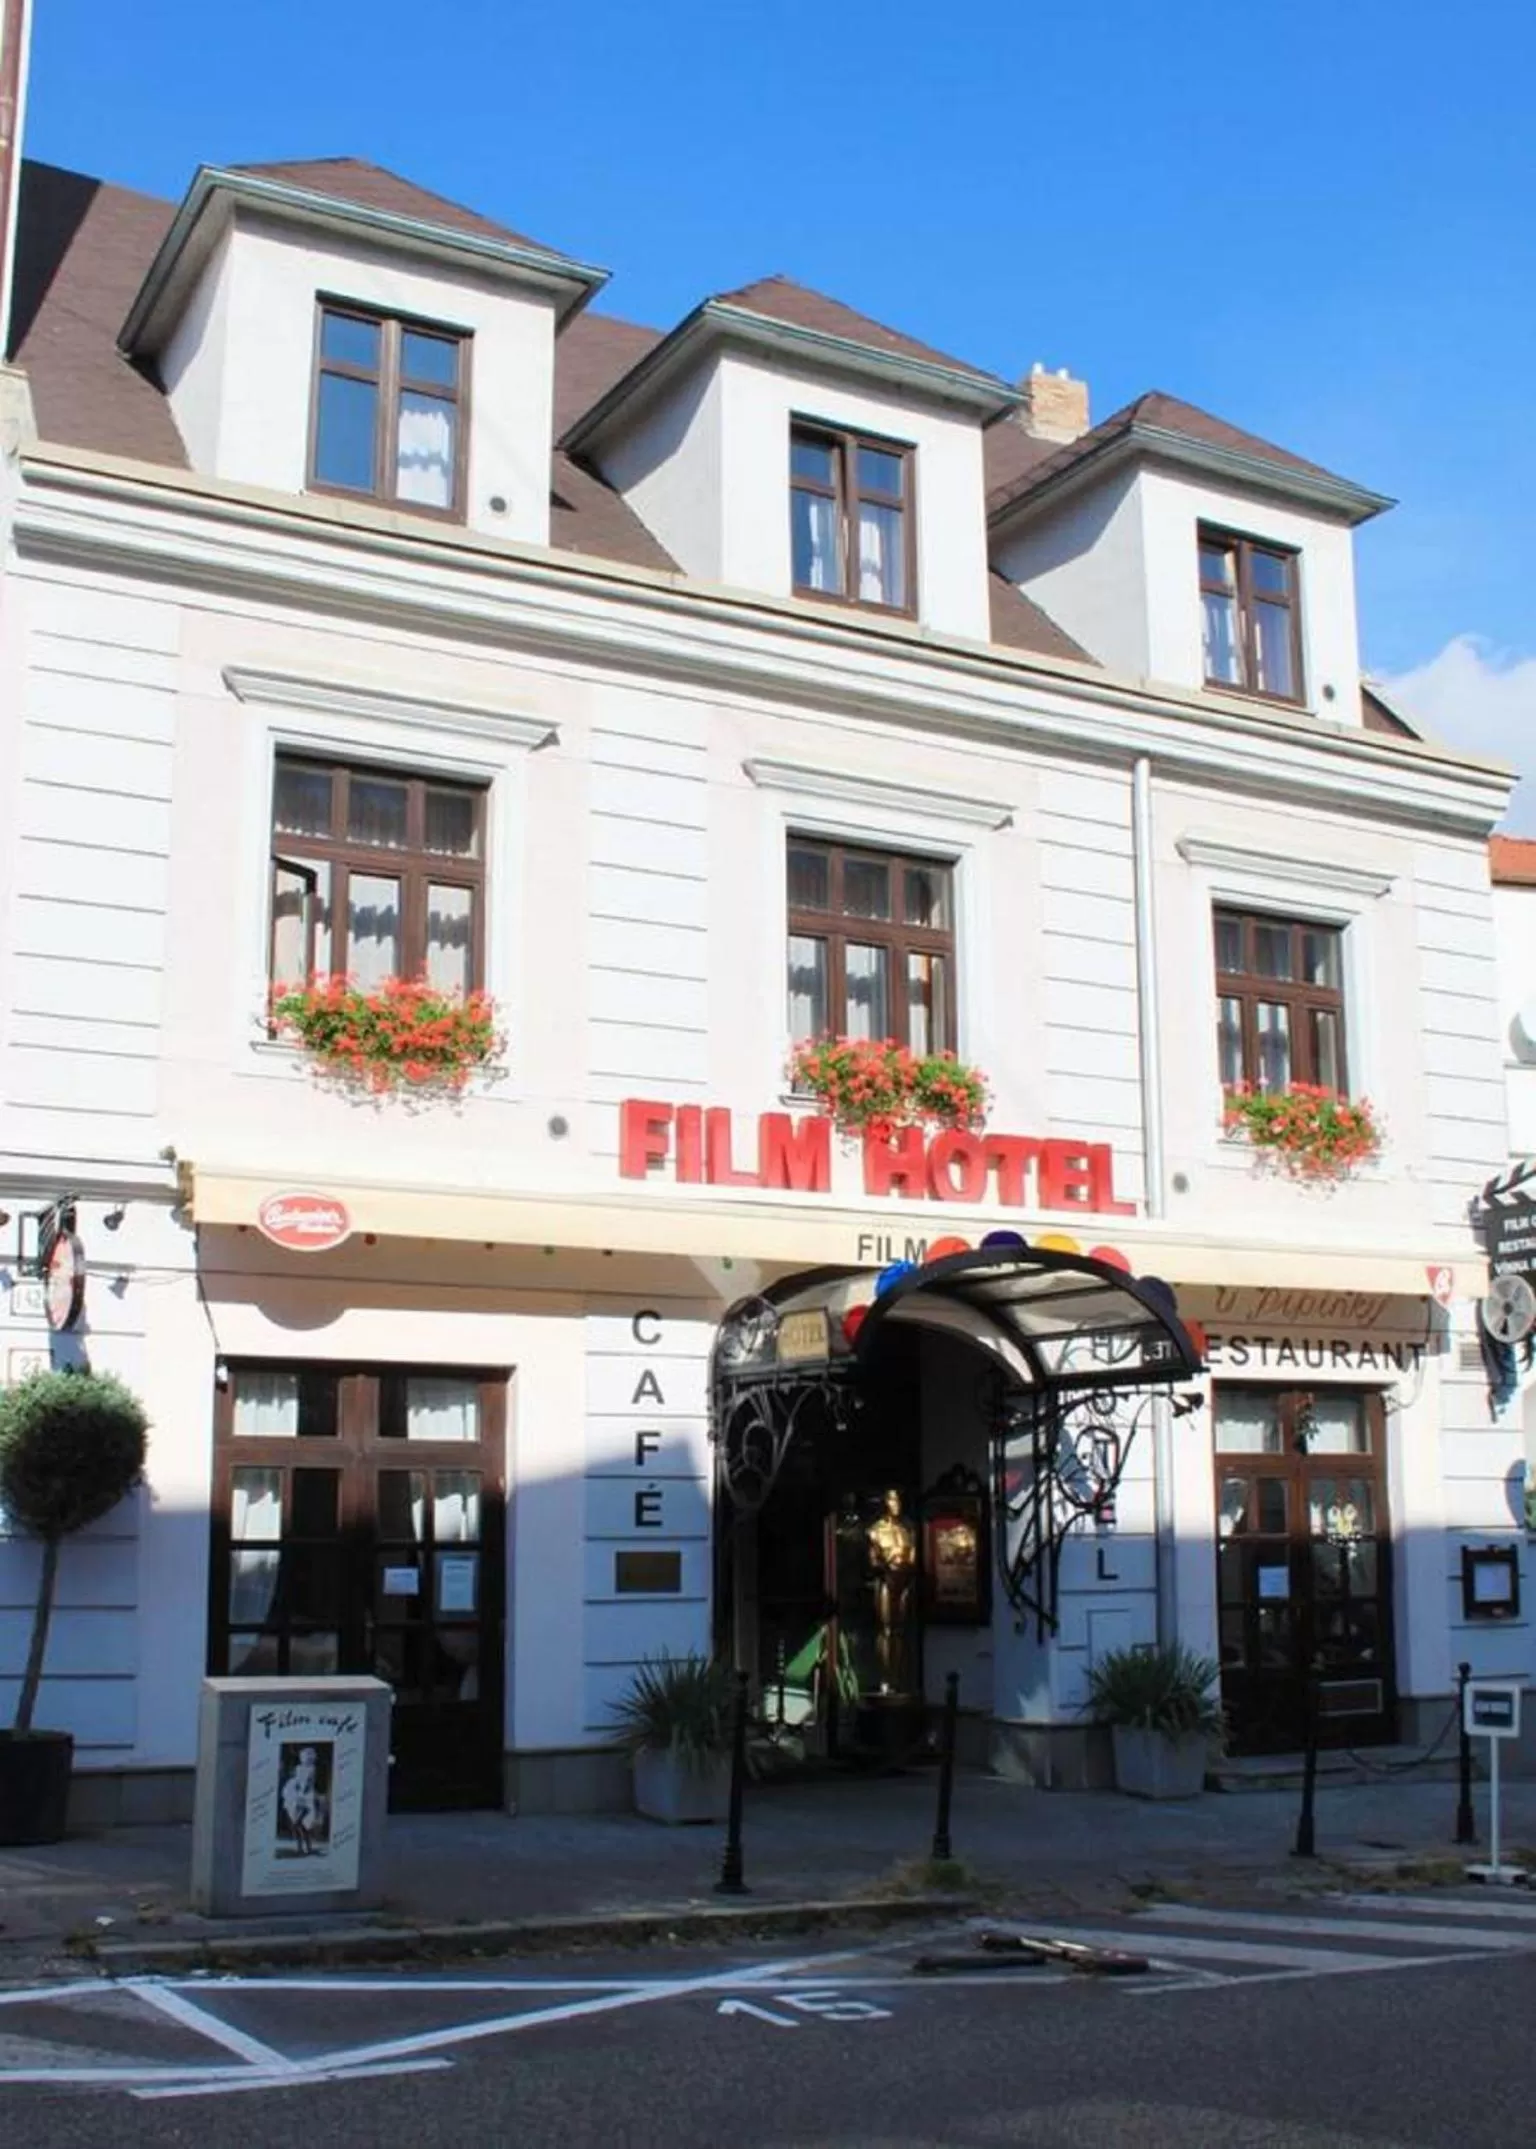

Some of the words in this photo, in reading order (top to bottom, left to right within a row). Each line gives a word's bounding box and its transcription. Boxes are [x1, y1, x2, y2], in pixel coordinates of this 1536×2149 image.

[619, 1098, 831, 1193] FILM
[863, 1124, 1138, 1216] HOTEL
[1204, 1334, 1427, 1372] ESTAURANT
[632, 1310, 665, 1528] CAFÉ
[717, 1991, 893, 2027] 15
